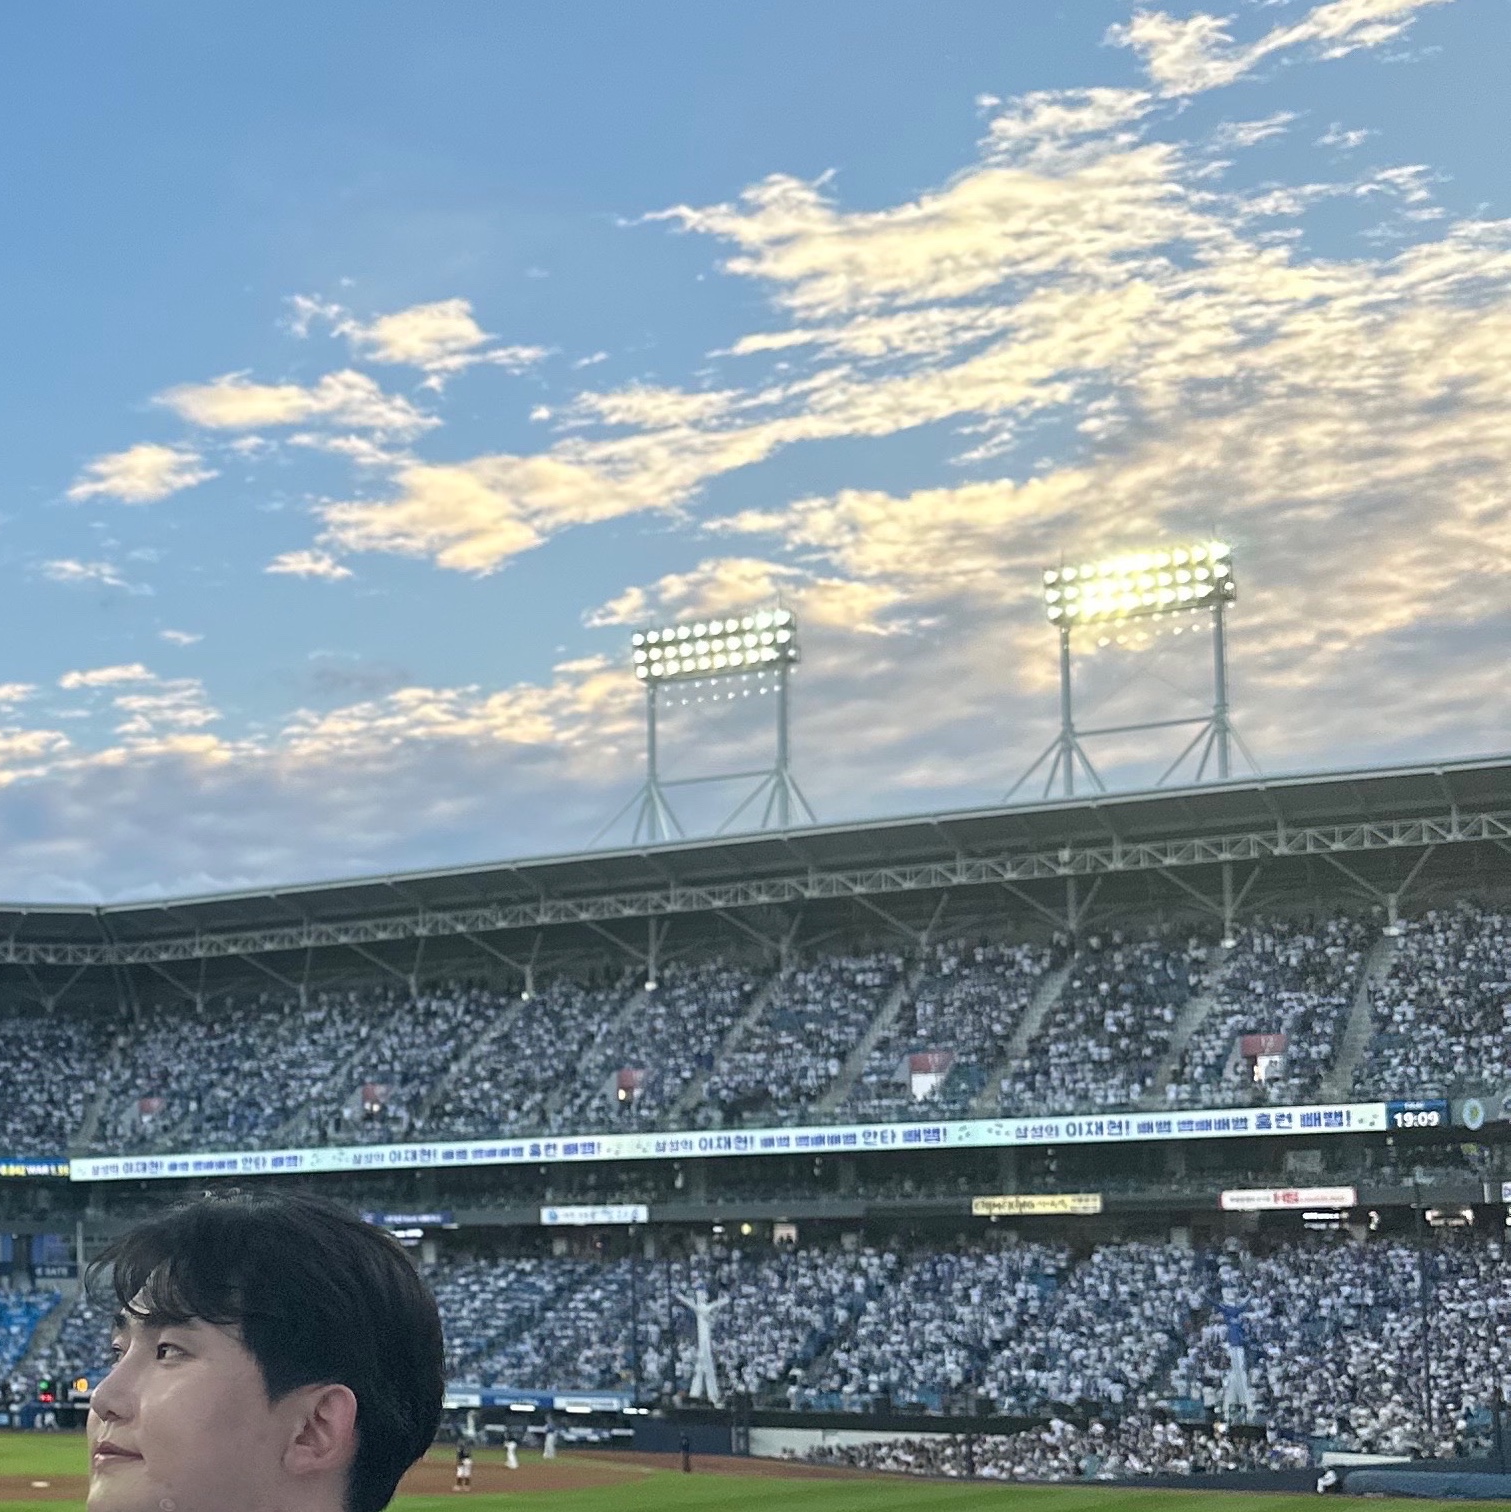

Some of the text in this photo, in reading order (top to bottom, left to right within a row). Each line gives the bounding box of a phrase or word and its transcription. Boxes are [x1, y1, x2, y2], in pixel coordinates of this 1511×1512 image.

[1066, 1119, 1130, 1138] 이재현!
[1255, 1112, 1292, 1130] 홈런
[1394, 1111, 1439, 1128] 19:09
